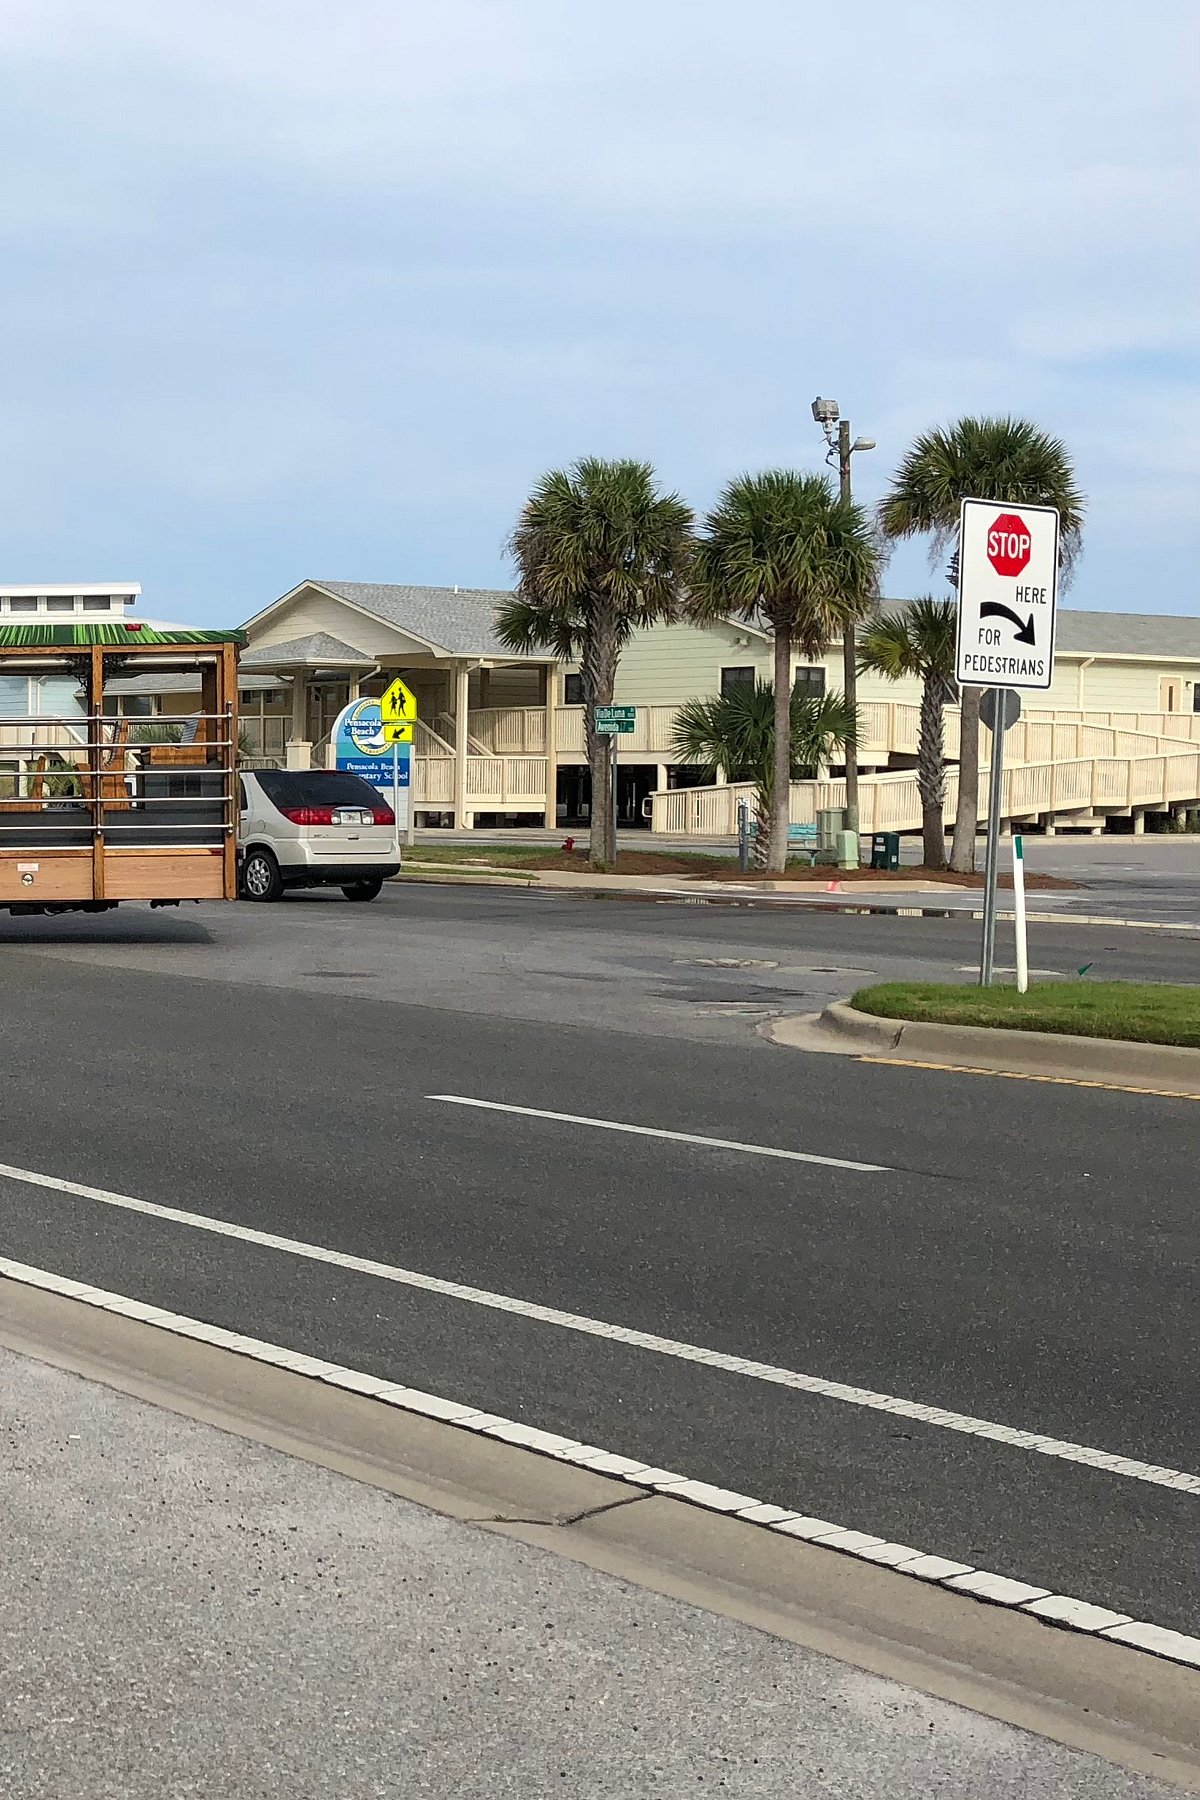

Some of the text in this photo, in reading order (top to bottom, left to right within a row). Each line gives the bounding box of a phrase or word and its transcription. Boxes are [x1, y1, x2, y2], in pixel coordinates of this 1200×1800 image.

[988, 531, 1030, 559] STOP
[1015, 585, 1047, 604] HERE
[978, 628, 1001, 646] FOR
[964, 654, 1044, 677] PEDESTRIANS
[344, 718, 381, 727] Pensacola
[351, 727, 375, 735] Beach
